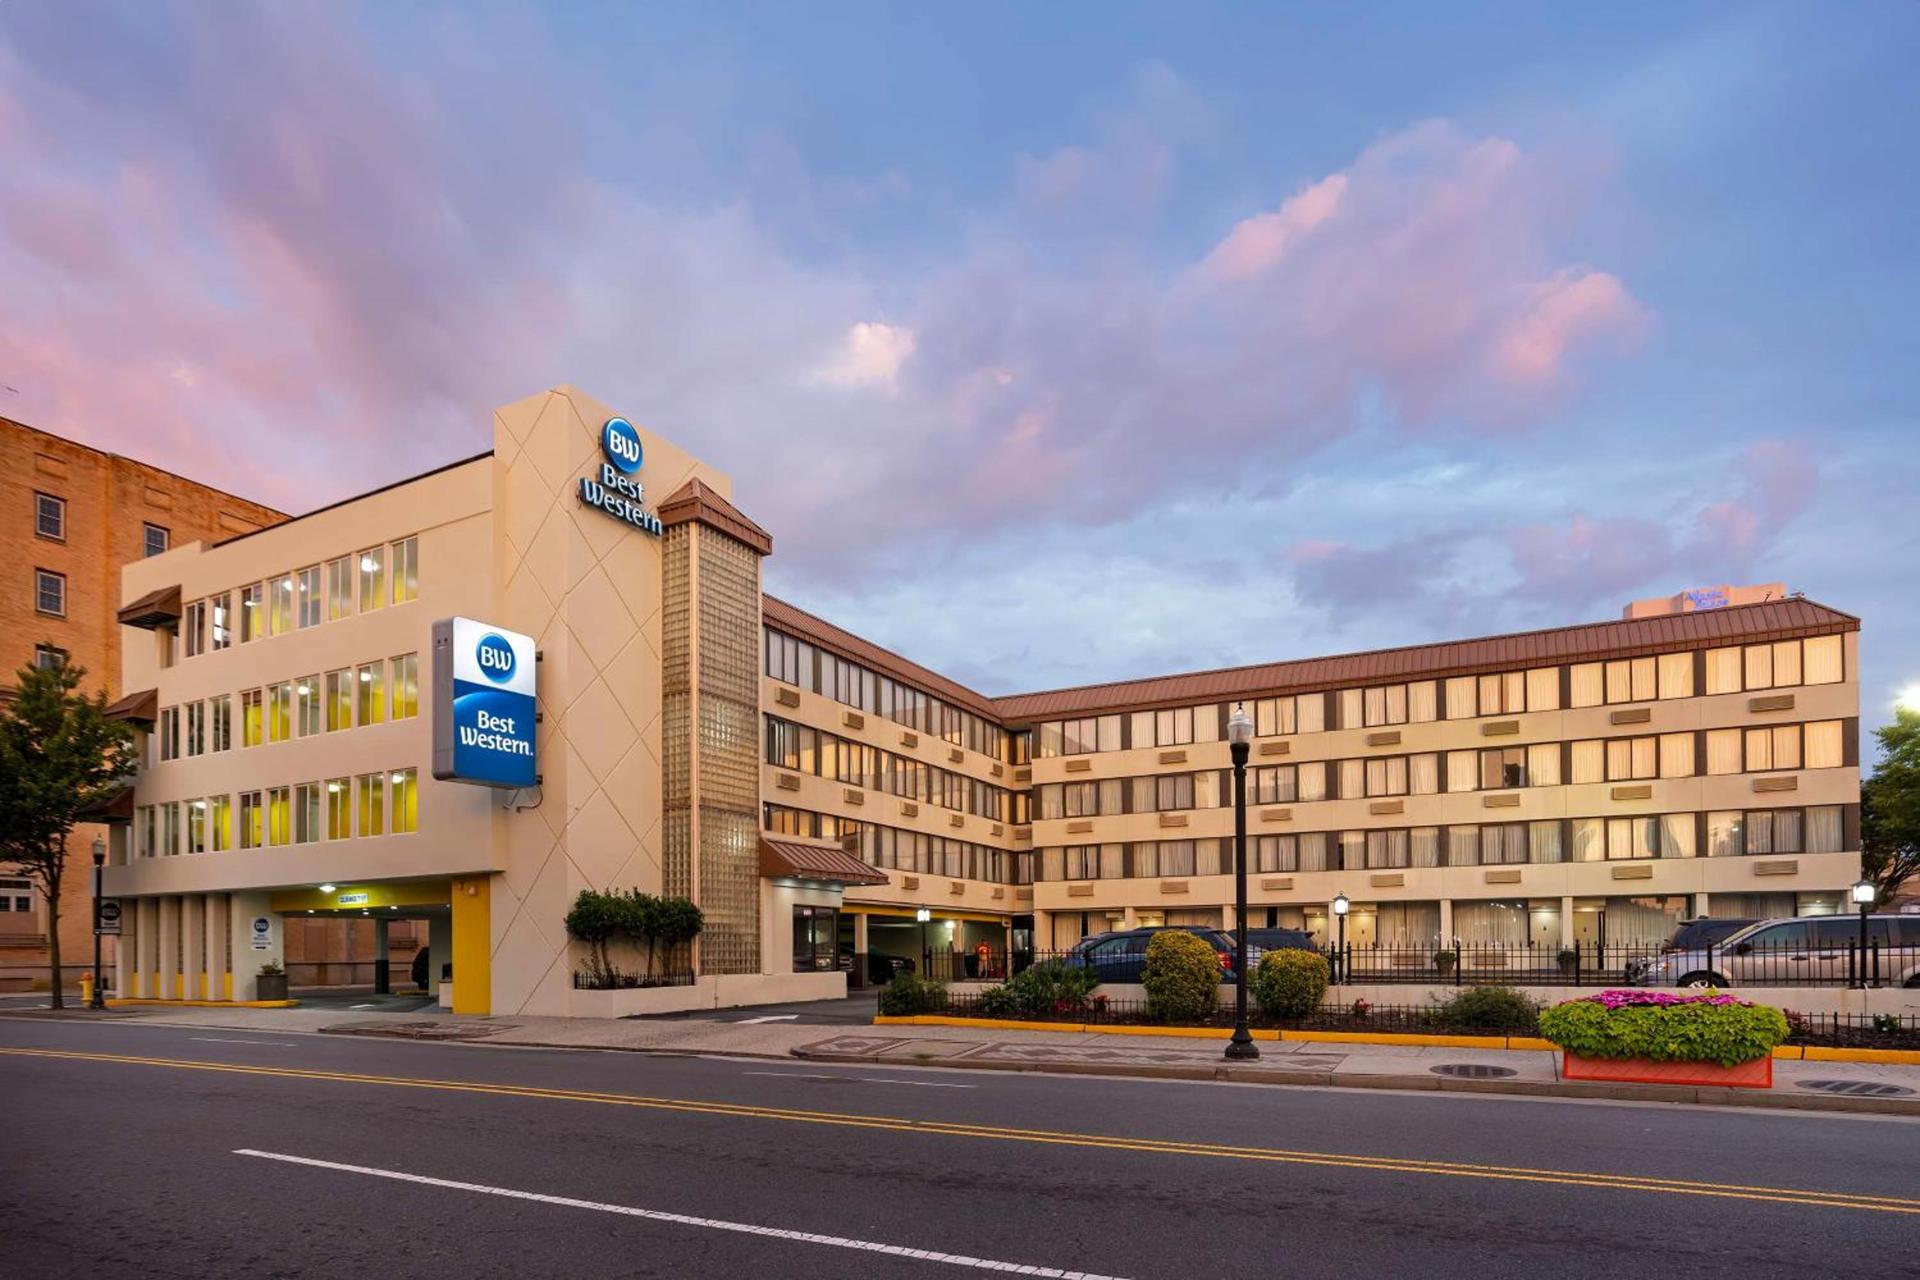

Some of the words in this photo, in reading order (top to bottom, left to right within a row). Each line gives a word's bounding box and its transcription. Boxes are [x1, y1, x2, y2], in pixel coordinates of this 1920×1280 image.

[610, 429, 639, 463] BW
[603, 463, 643, 502] Best
[583, 479, 663, 535] Western
[480, 645, 512, 671] BW
[477, 710, 515, 735] Best
